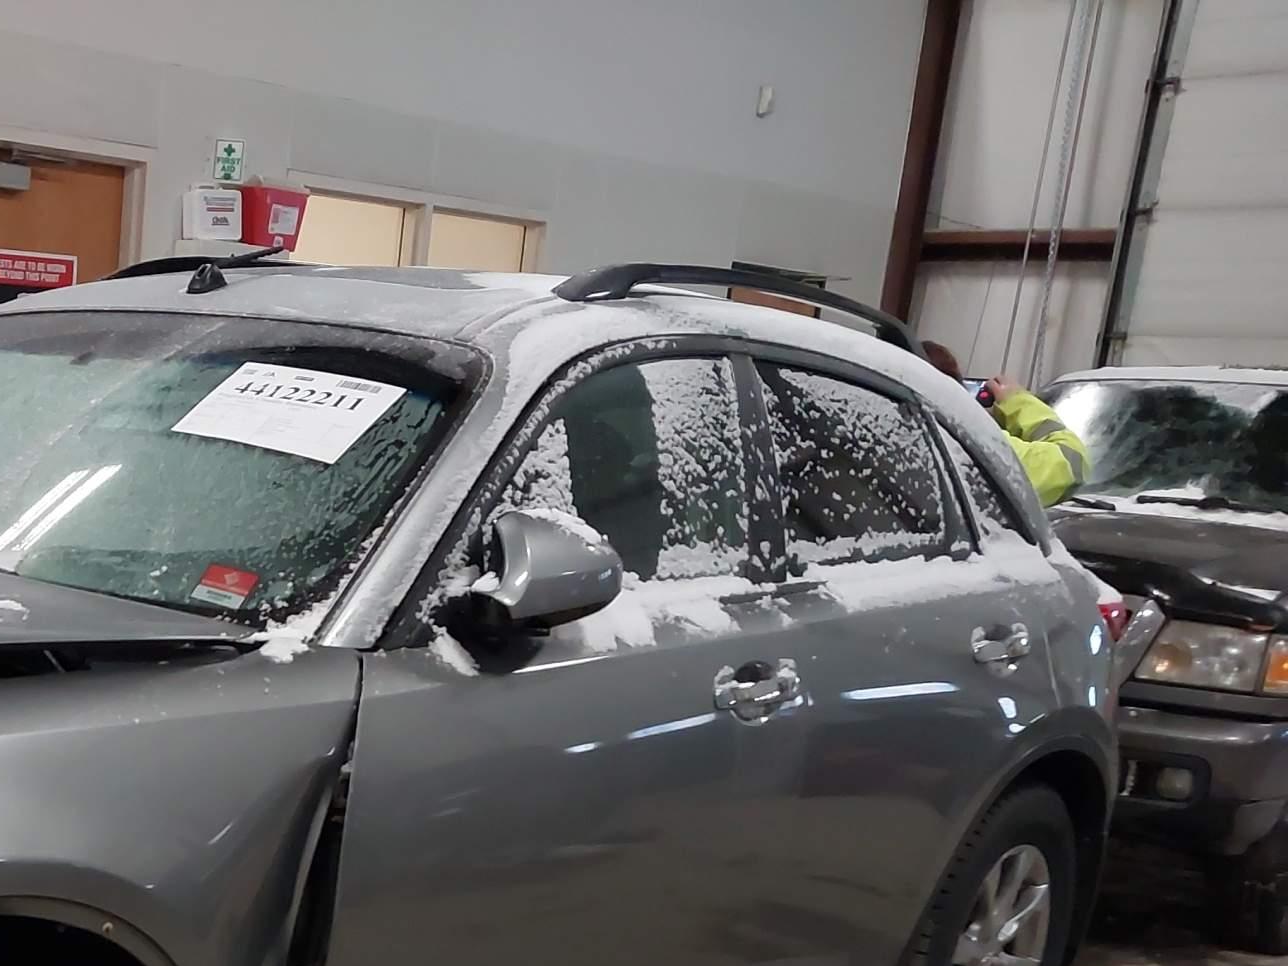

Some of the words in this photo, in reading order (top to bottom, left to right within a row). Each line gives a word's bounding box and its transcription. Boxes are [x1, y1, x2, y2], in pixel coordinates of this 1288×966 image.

[216, 156, 241, 165] FIRST
[220, 165, 236, 173] AID
[234, 382, 365, 411] 44122211
